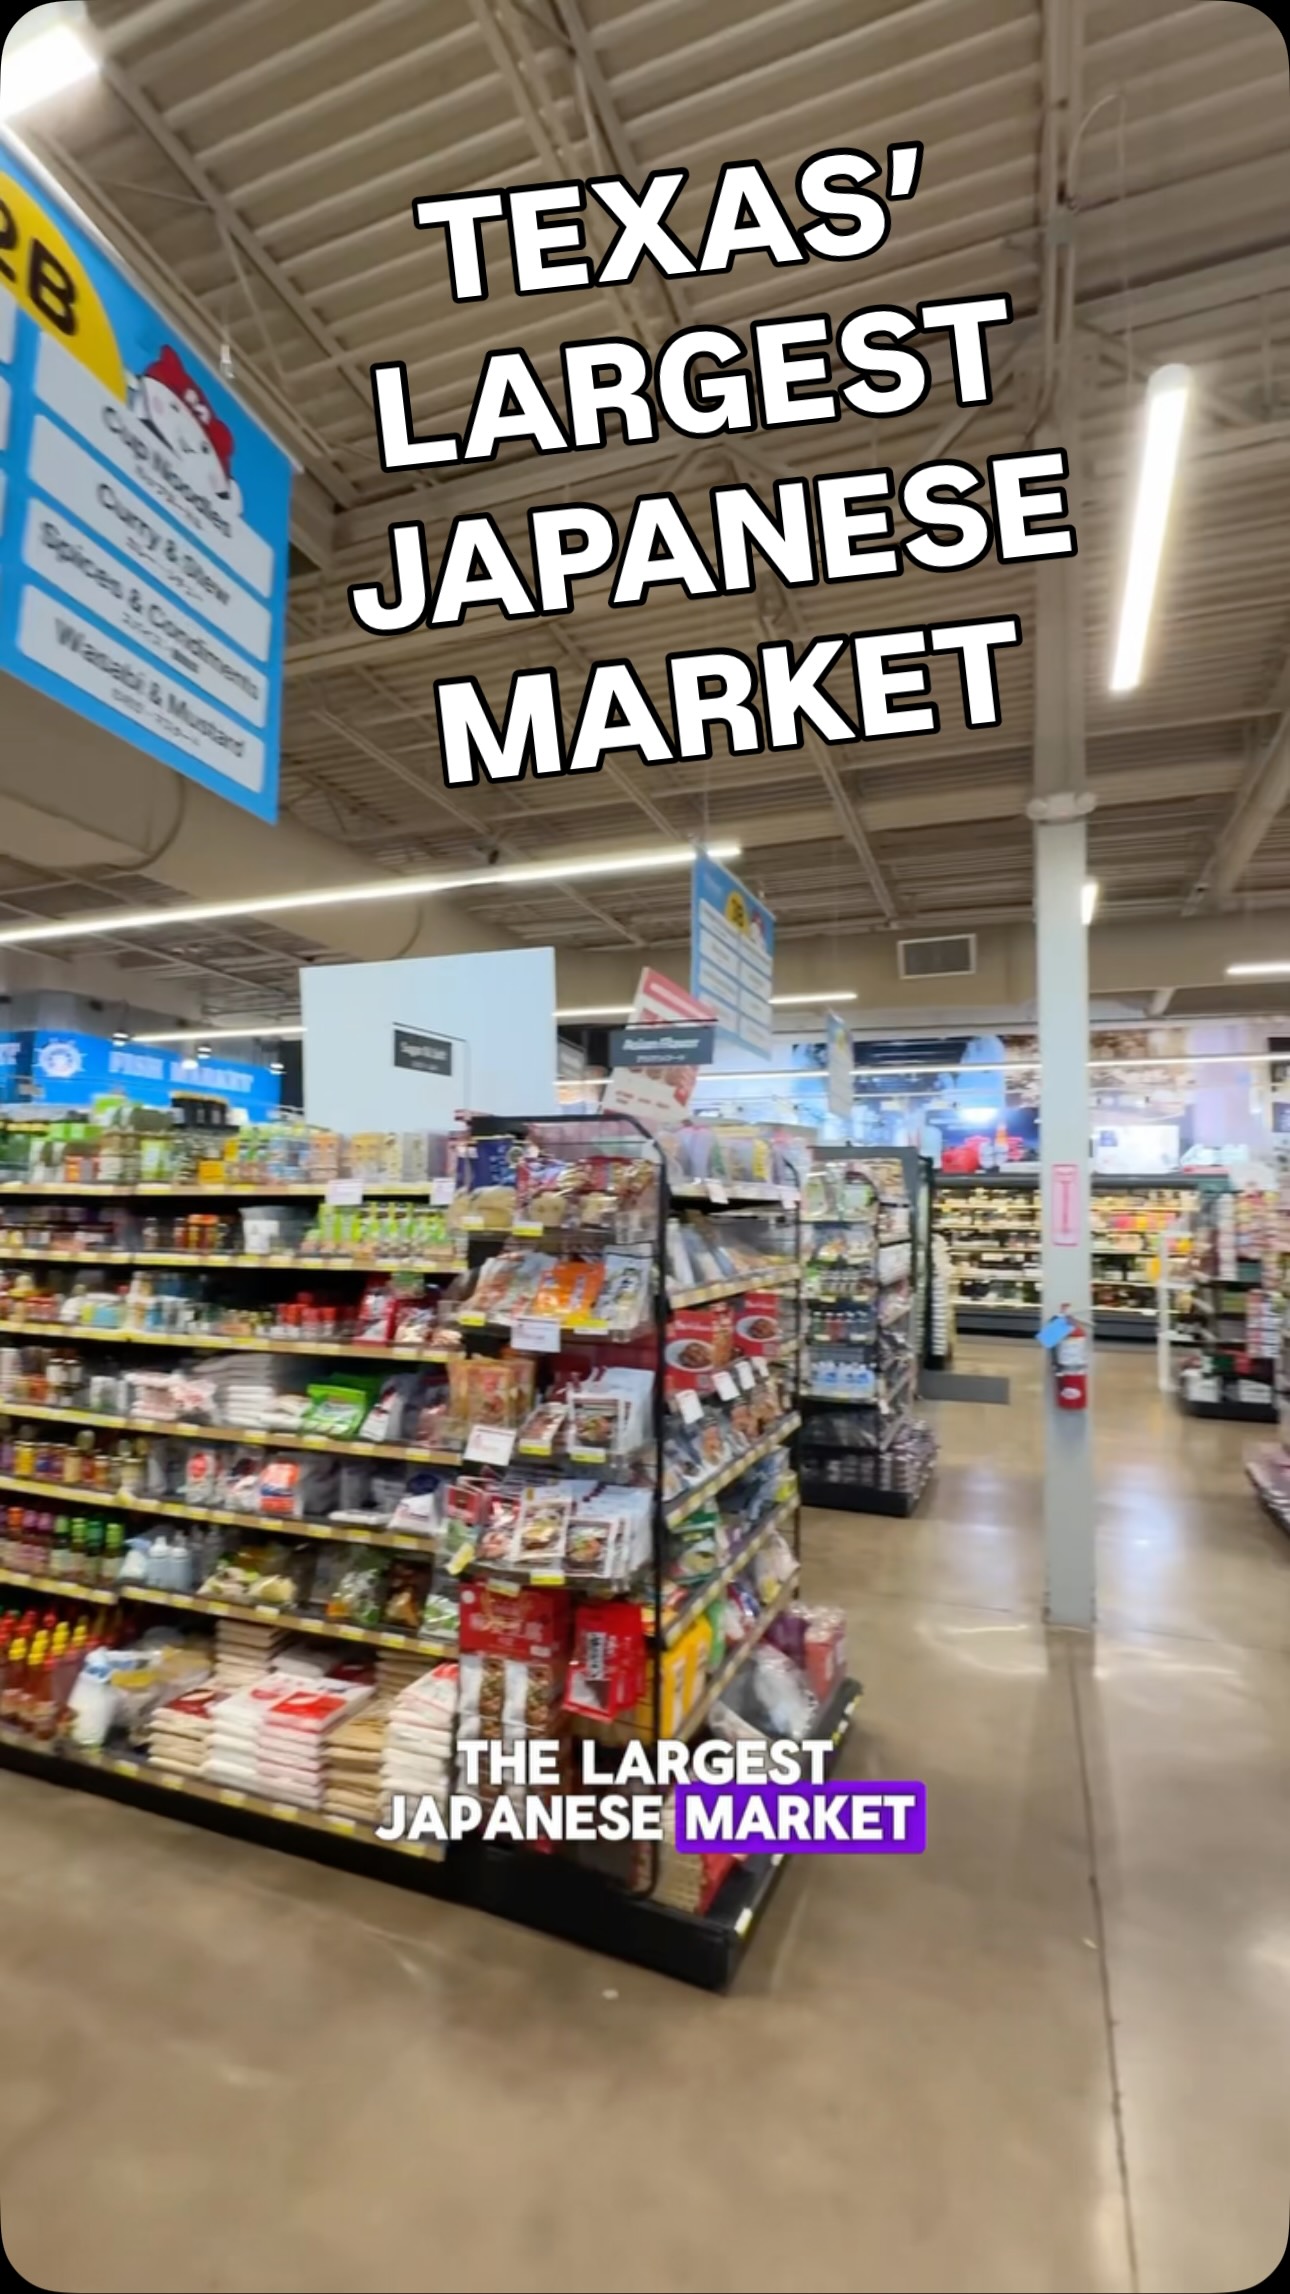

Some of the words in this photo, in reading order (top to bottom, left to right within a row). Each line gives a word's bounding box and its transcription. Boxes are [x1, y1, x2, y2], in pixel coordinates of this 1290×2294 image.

[102, 405, 146, 460] Cup
[152, 450, 232, 539] Noodles
[39, 519, 124, 602] Spices
[128, 587, 143, 616] &
[148, 602, 259, 701] Condiments
[97, 483, 160, 549] Curry
[164, 538, 178, 566] &
[182, 551, 230, 606] Stew
[55, 617, 144, 696] Wasabi
[148, 680, 163, 709] &
[167, 691, 245, 759] Mustard
